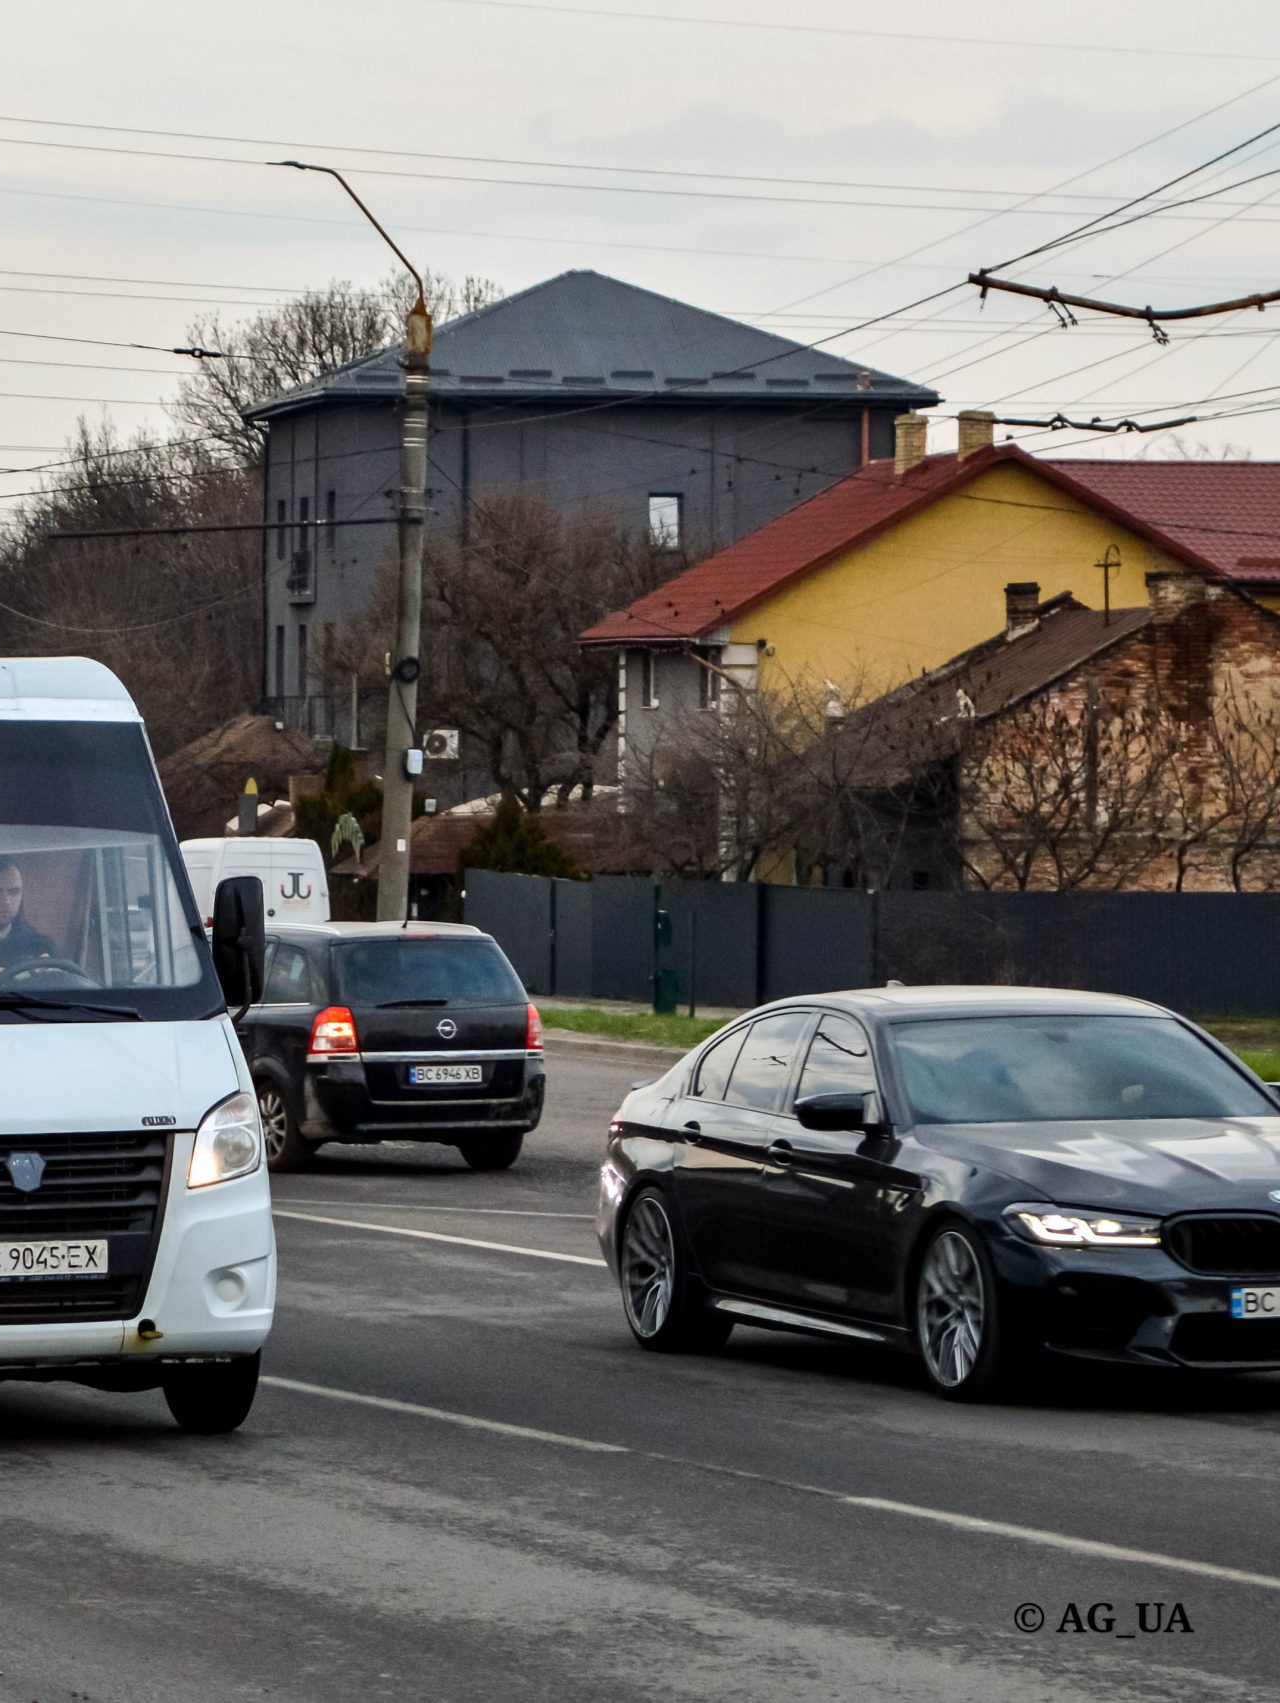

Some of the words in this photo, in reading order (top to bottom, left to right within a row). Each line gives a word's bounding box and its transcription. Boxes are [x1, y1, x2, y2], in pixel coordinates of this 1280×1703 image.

[417, 1068, 433, 1080] BC
[435, 1068, 462, 1080] 6946
[464, 1067, 480, 1080] XB
[9, 1246, 60, 1270] 9045
[68, 1245, 98, 1269] EX
[1244, 1291, 1276, 1313] BC
